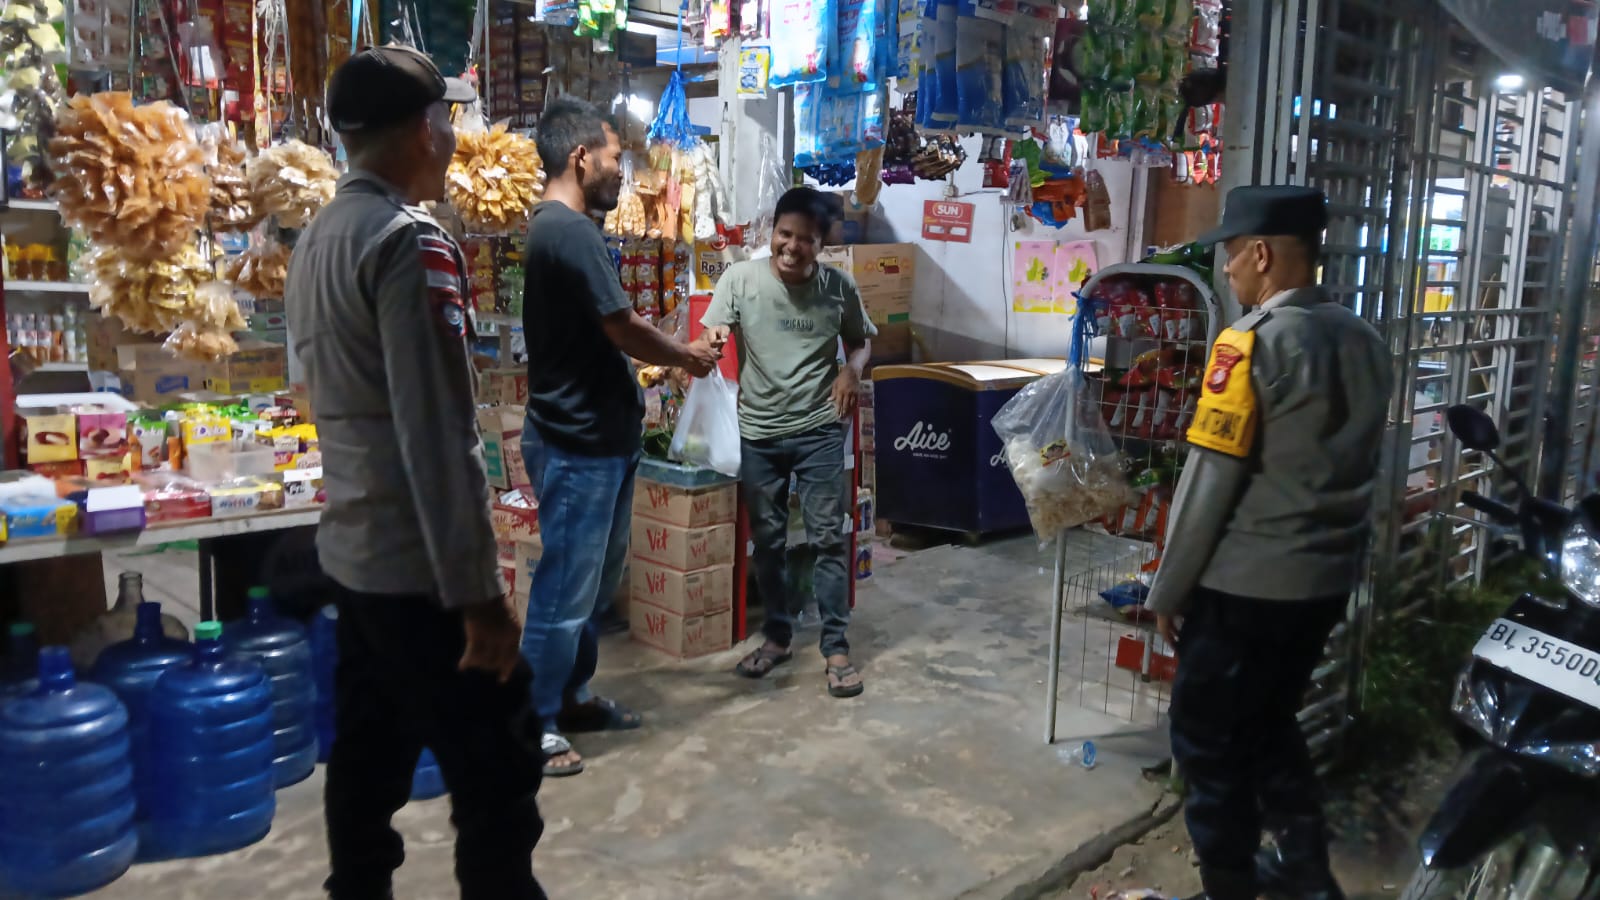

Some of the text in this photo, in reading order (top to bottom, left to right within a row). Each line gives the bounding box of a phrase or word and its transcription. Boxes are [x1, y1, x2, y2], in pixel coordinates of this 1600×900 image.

[937, 204, 959, 216] SUN
[894, 421, 950, 451] Aice
[646, 485, 670, 509] Vit
[646, 527, 670, 552] Vit
[645, 571, 667, 594] Vit
[645, 612, 668, 636] Vit
